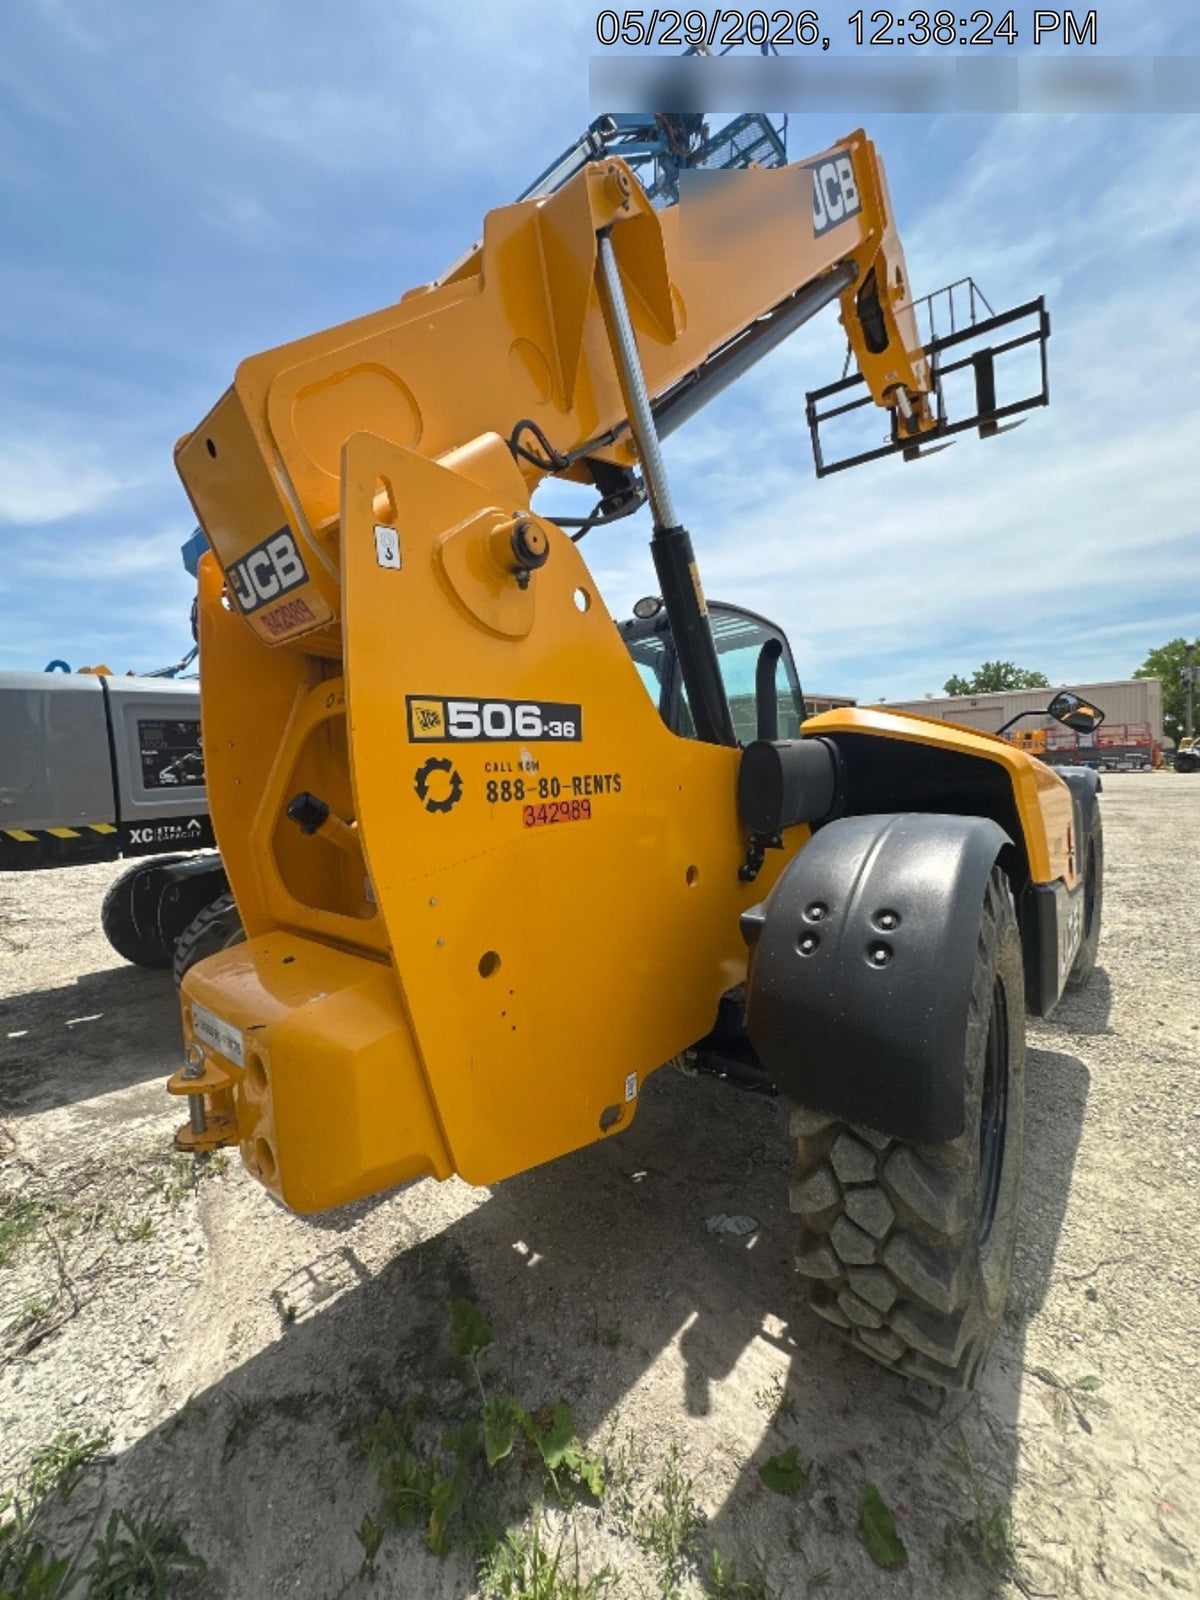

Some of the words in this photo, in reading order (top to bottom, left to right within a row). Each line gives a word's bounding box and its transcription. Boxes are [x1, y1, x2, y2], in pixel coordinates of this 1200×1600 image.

[813, 158, 860, 230] JCB
[237, 534, 305, 610] JCB
[485, 762, 513, 772] CALL
[518, 760, 540, 772] NOW
[486, 774, 622, 803] 888-80-RENTS
[525, 799, 591, 827] 342989
[129, 828, 153, 843] XC
